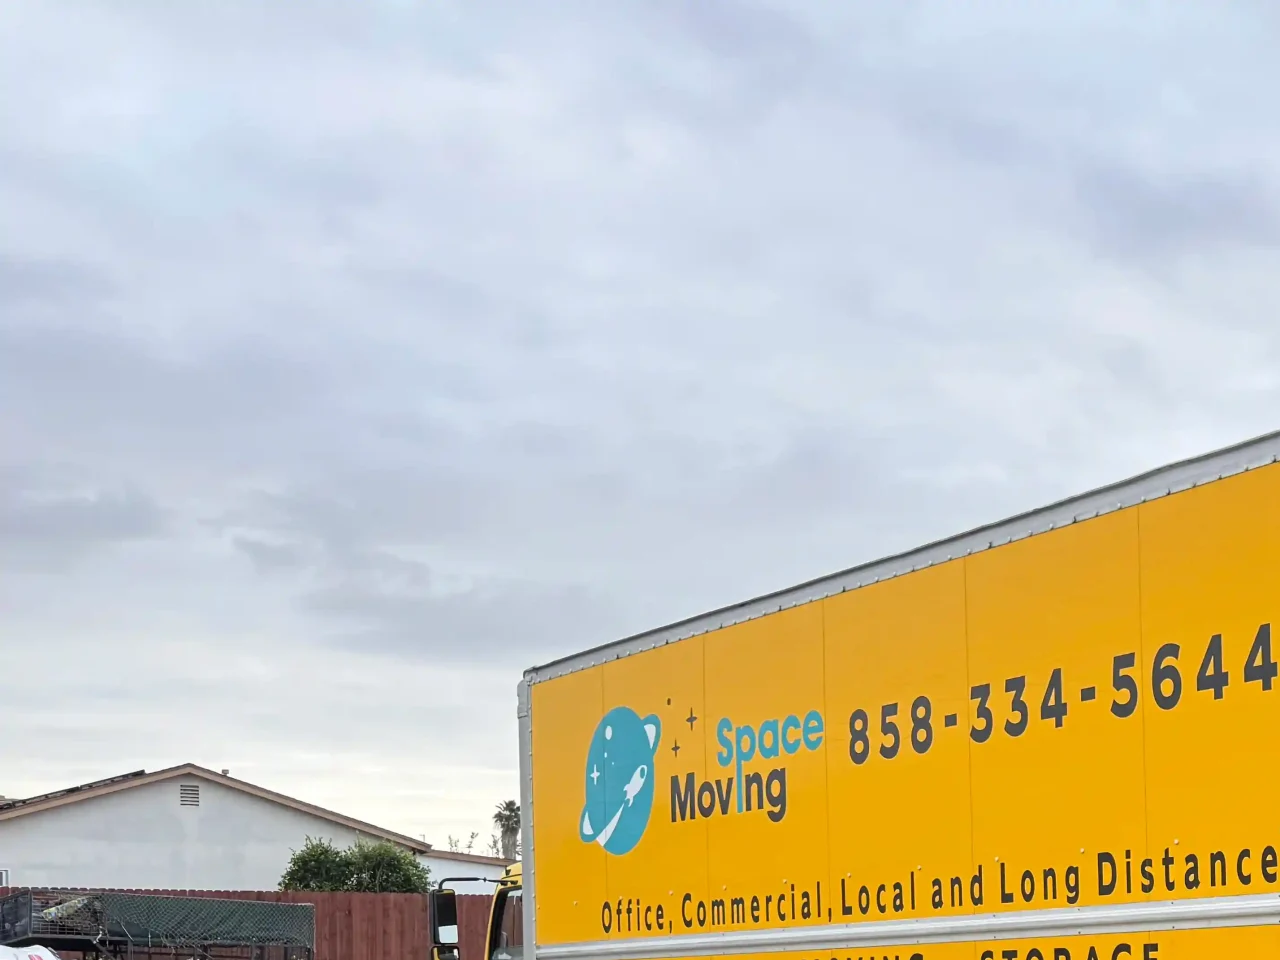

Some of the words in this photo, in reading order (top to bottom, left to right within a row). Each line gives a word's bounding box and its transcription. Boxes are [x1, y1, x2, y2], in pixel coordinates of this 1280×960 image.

[849, 623, 1279, 765] 858-334-5644
[670, 766, 787, 823] Moving
[716, 709, 825, 813] Space
[601, 897, 674, 935] Office,
[681, 881, 832, 928] Commercial,
[841, 871, 916, 916] Local
[931, 864, 983, 909] and
[1000, 862, 1080, 905] Long
[1097, 845, 1279, 896] Distance
